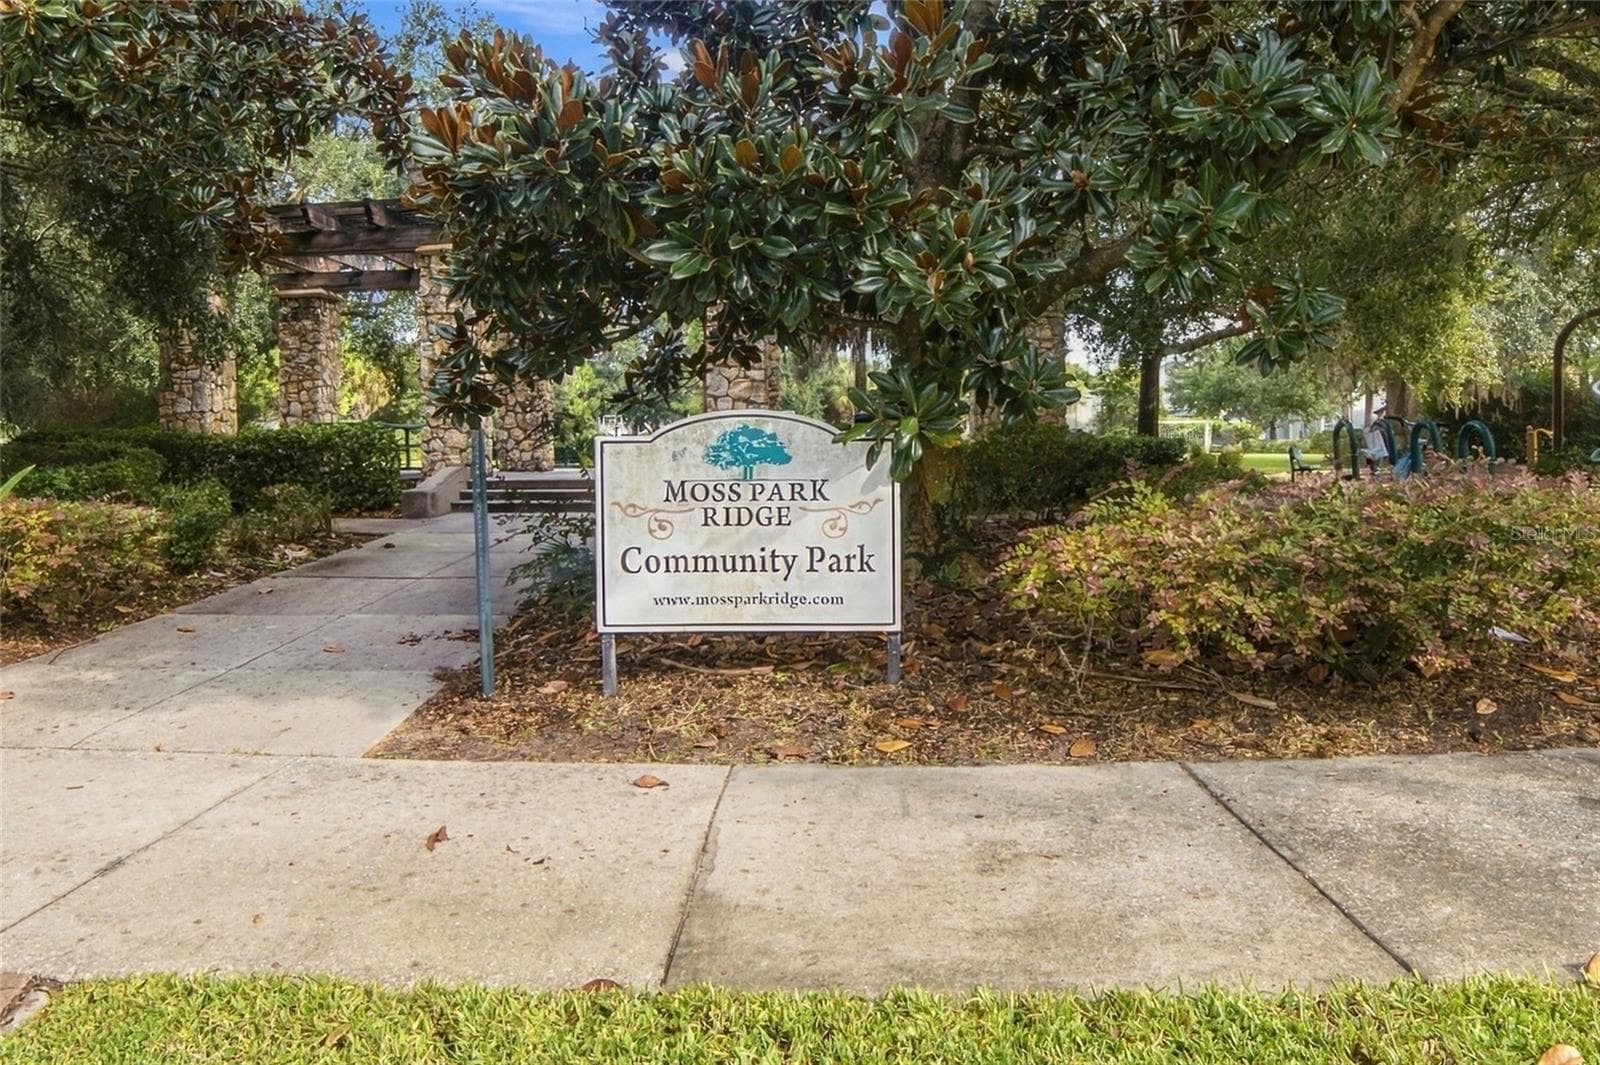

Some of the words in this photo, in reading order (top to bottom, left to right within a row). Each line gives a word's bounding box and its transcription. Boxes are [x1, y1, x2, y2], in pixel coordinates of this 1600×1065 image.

[663, 480, 742, 503] MOSS
[749, 479, 831, 502] PARK
[701, 507, 792, 527] RIDGE
[620, 546, 799, 581] Community
[806, 544, 876, 573] Park
[653, 592, 844, 608] www.mossparkridge.com
